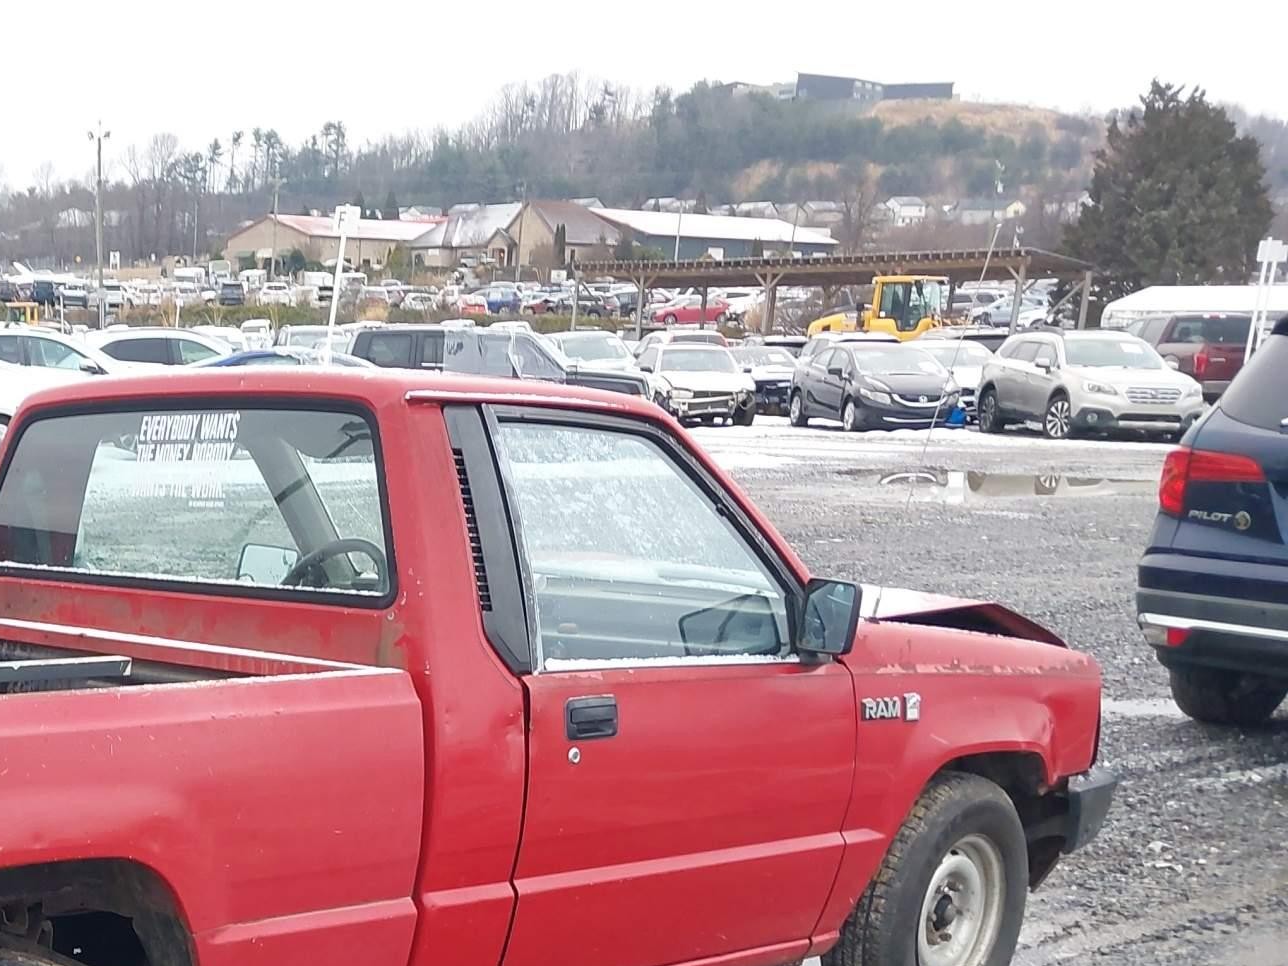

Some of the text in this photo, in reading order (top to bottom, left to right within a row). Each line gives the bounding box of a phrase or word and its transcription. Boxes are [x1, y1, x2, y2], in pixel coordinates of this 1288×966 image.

[140, 414, 201, 441] EVERYBODY
[1188, 510, 1233, 522] PILOT
[861, 696, 901, 720] RAM
